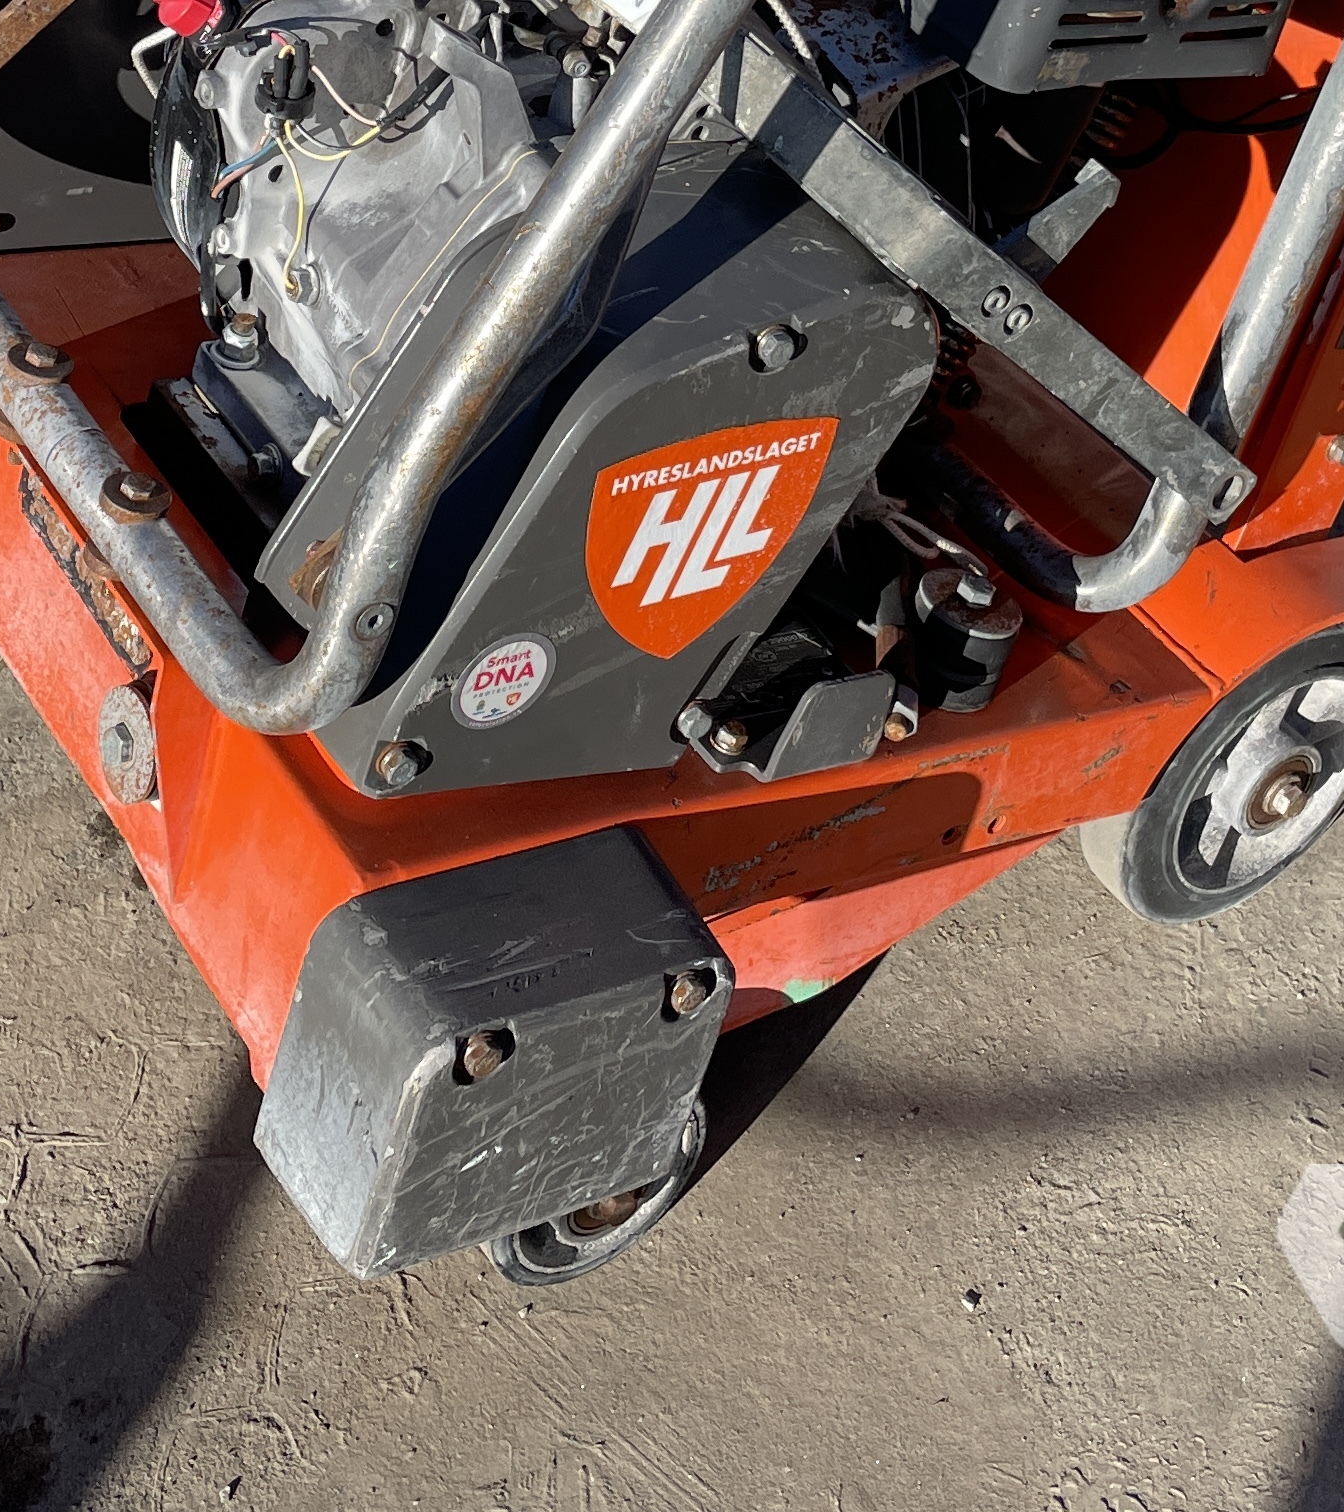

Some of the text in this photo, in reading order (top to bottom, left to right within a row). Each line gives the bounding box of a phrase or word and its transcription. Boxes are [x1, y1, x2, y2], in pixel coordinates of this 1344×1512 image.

[611, 432, 822, 497] HYRESLANDSLAGET
[610, 464, 782, 608] HLL
[487, 649, 533, 669] Smart
[473, 662, 535, 691] DNA
[473, 681, 530, 699] PROTECTION
